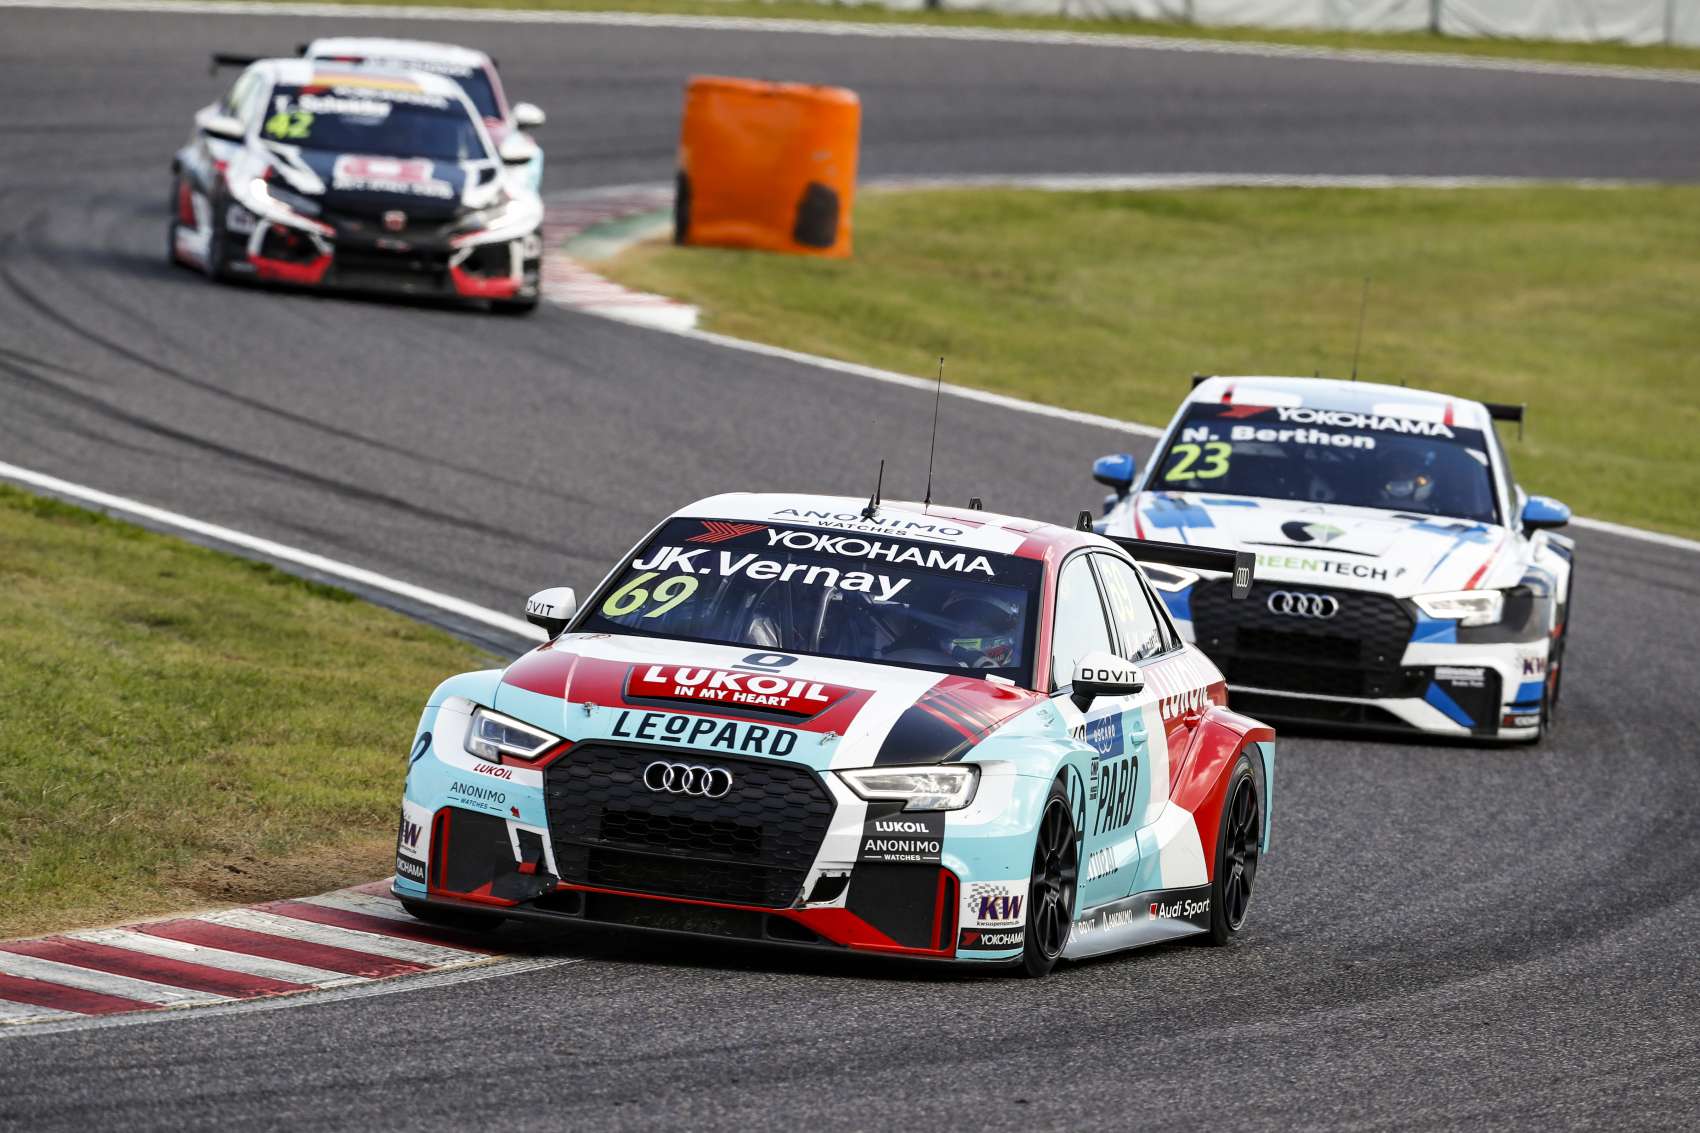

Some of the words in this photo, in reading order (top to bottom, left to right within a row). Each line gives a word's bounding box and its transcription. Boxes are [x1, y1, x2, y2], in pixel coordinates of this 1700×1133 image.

[266, 112, 314, 138] 42
[1276, 407, 1454, 438] YOKOHAMA
[1181, 426, 1219, 443] N.
[1231, 426, 1376, 450] Berthon
[1165, 441, 1232, 482] 23
[773, 508, 964, 536] ANONIMO
[818, 520, 907, 536] WATCHES
[767, 528, 995, 576] YOKOHAMA
[632, 546, 912, 601] JK.Vernay
[602, 572, 699, 618] 69
[642, 665, 829, 702] LUKOIL
[1081, 668, 1137, 683] DOVIT
[674, 686, 694, 696] IN
[701, 688, 729, 700] MY
[732, 692, 790, 707] HEART
[611, 710, 799, 756] LEOPARD
[473, 763, 513, 780] LUKOIL
[450, 781, 506, 804] ANONIMO
[460, 798, 489, 810] WATCHES
[875, 821, 930, 833] LUKOIL
[864, 839, 940, 853] ANONIMO
[977, 894, 1024, 921] KW
[1158, 900, 1183, 919] Audi
[1183, 897, 1210, 920] Sport
[980, 932, 1024, 946] YOKOHAMA
